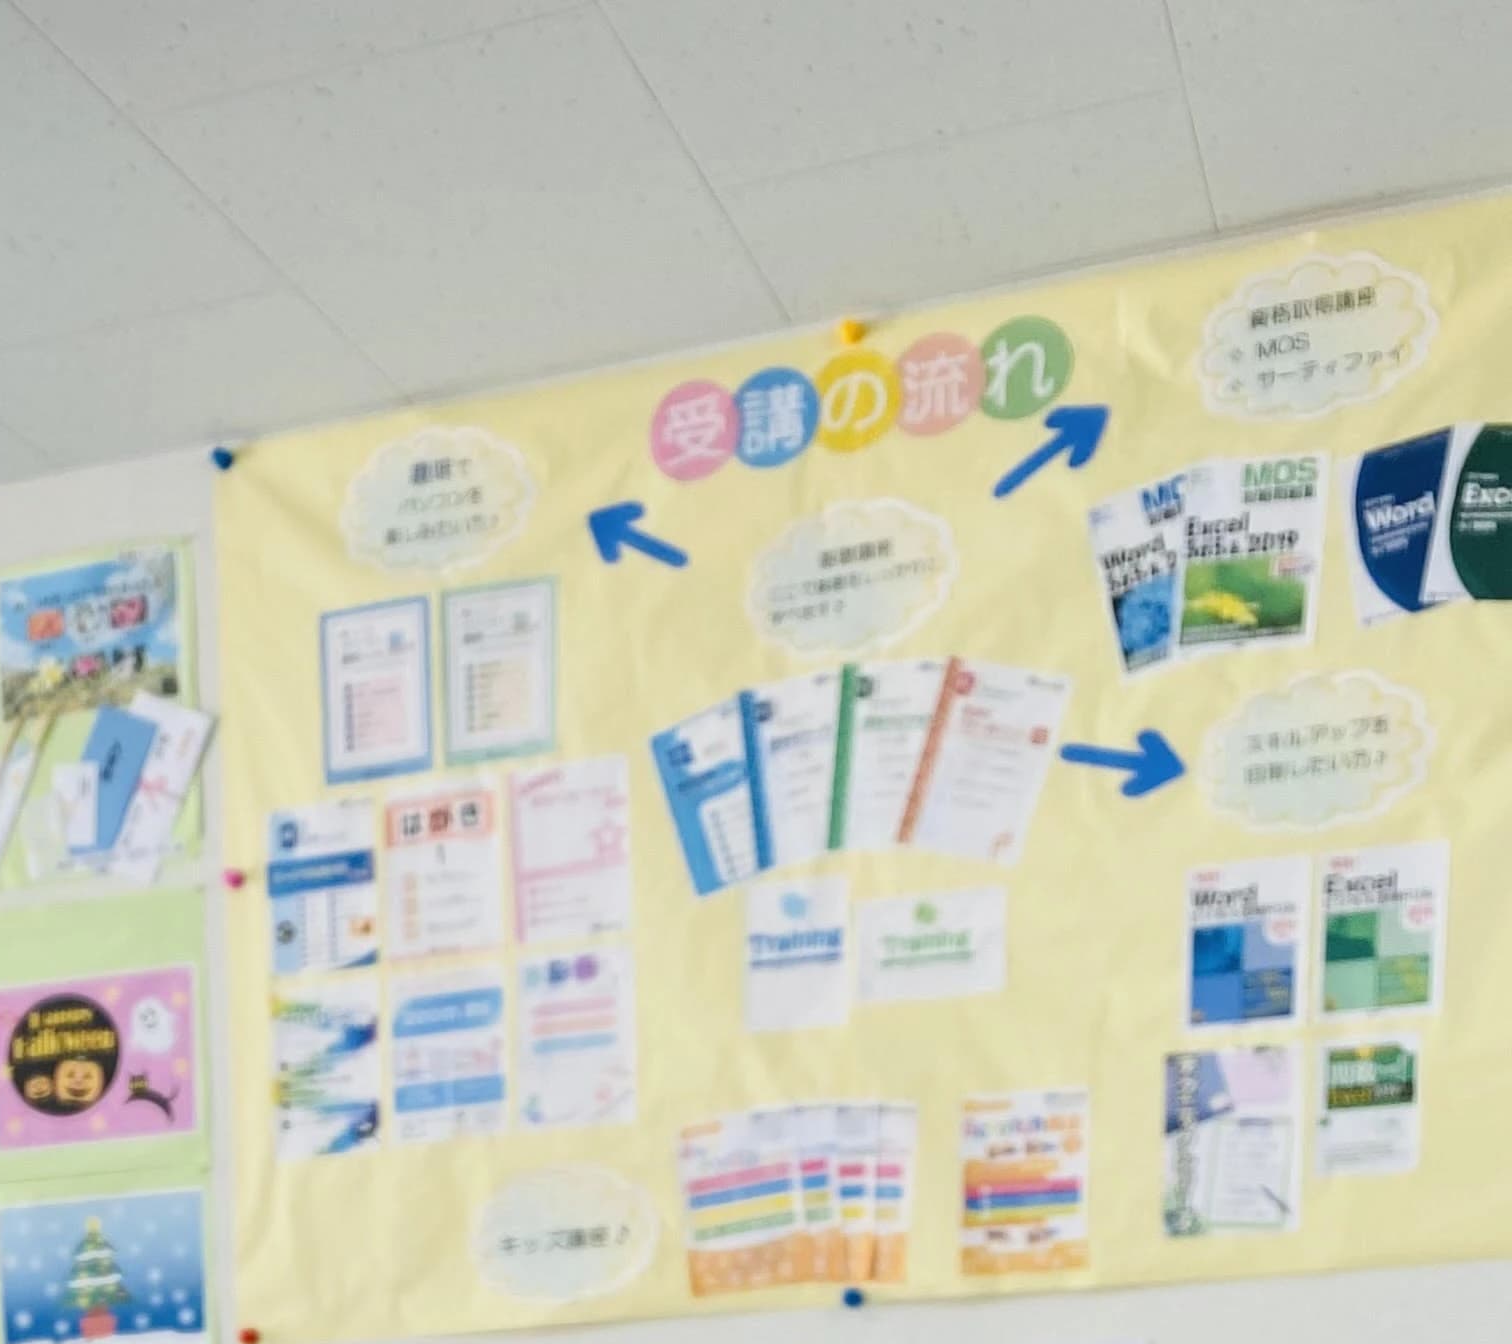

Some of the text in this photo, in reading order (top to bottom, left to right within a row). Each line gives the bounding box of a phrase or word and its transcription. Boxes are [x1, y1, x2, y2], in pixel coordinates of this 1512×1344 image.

[1256, 331, 1311, 361] MOS
[664, 338, 1055, 468] 受講の流れ
[1240, 456, 1319, 488] MOS
[1365, 490, 1435, 531] Word
